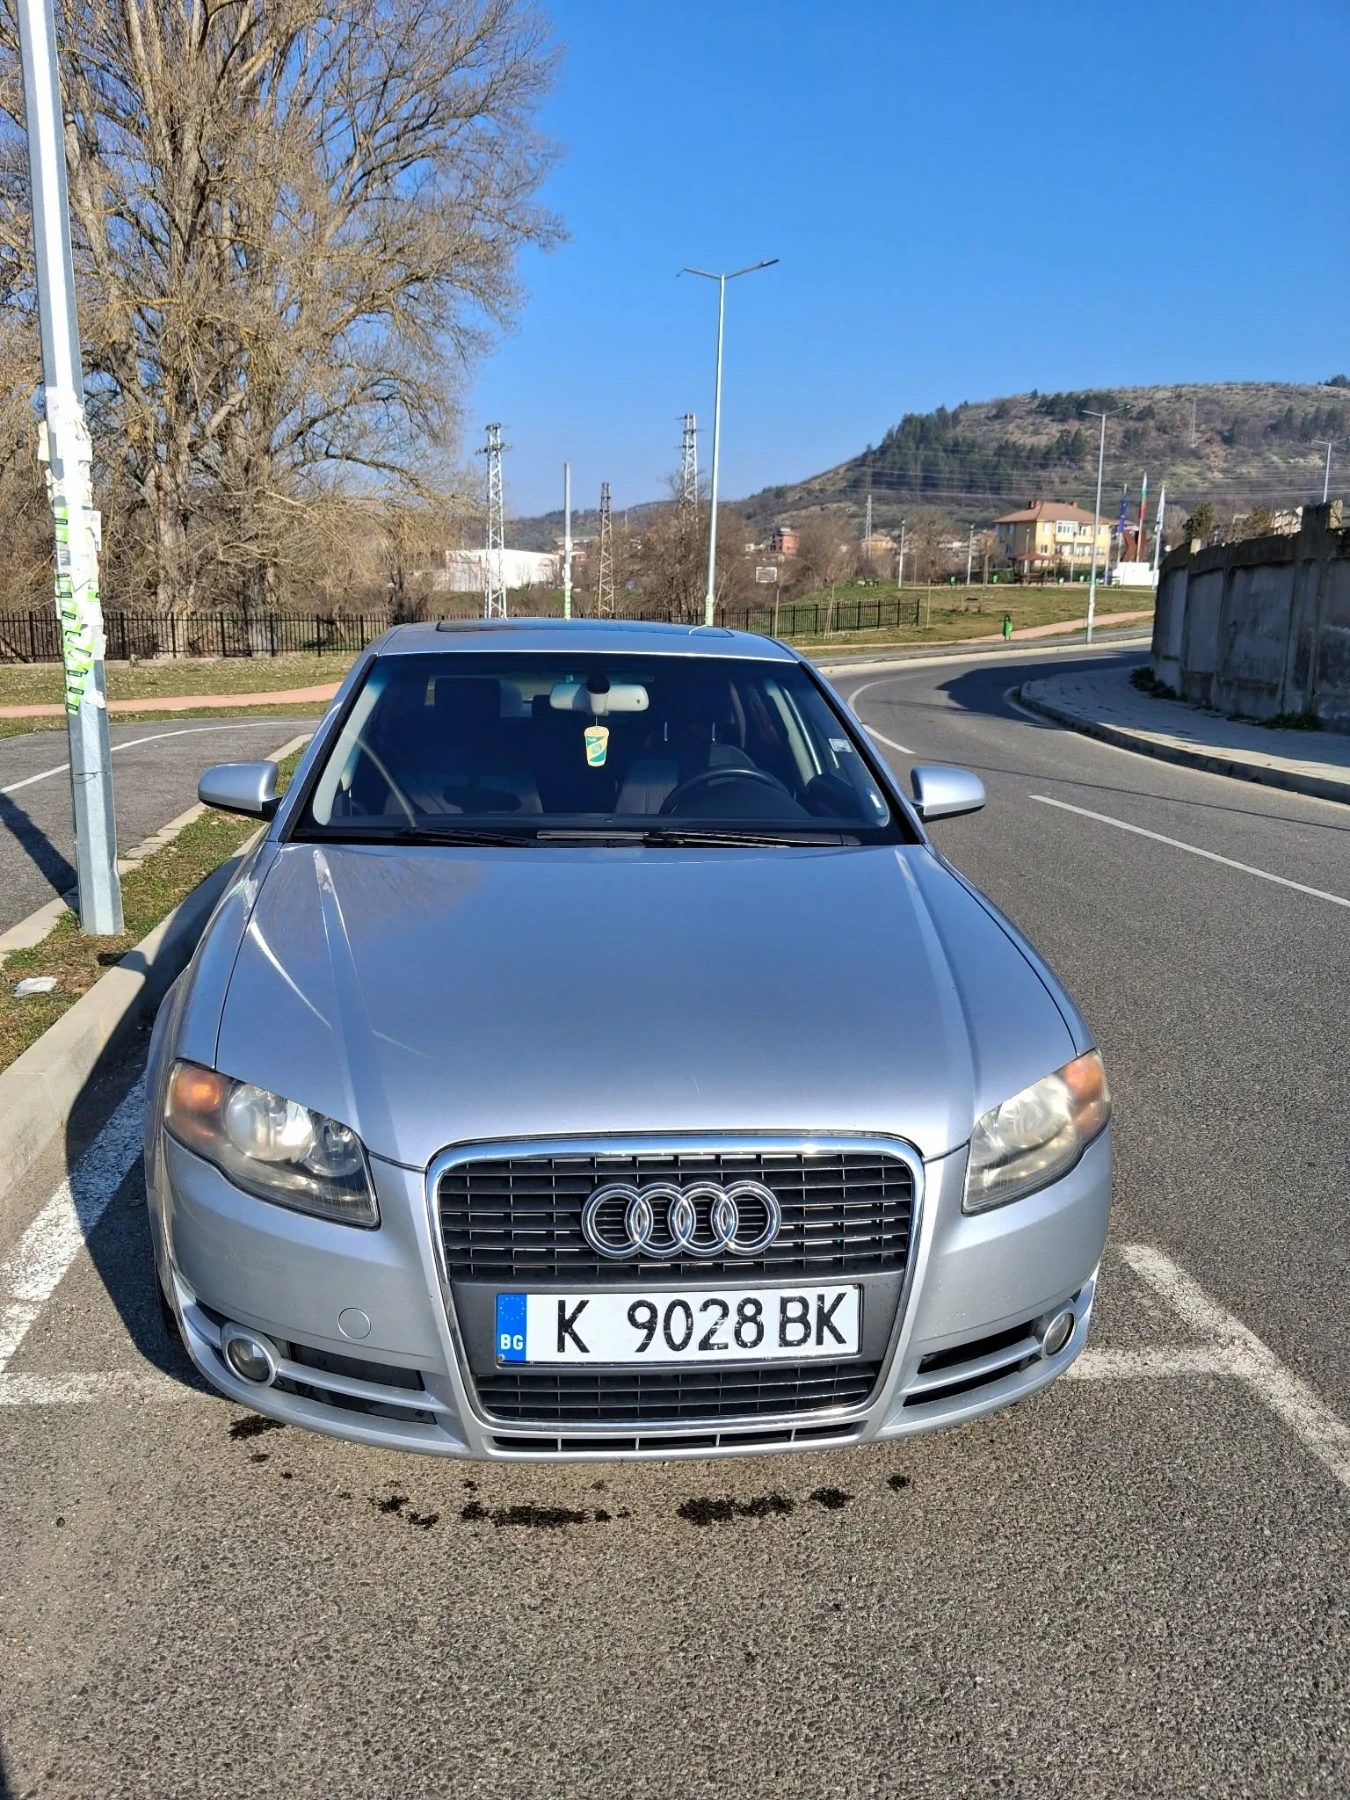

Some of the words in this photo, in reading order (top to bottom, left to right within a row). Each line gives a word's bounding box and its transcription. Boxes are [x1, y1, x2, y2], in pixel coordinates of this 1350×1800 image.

[500, 1333, 524, 1350] BG
[557, 1299, 590, 1353] K
[627, 1297, 765, 1352] 9028
[778, 1292, 847, 1348] BK
